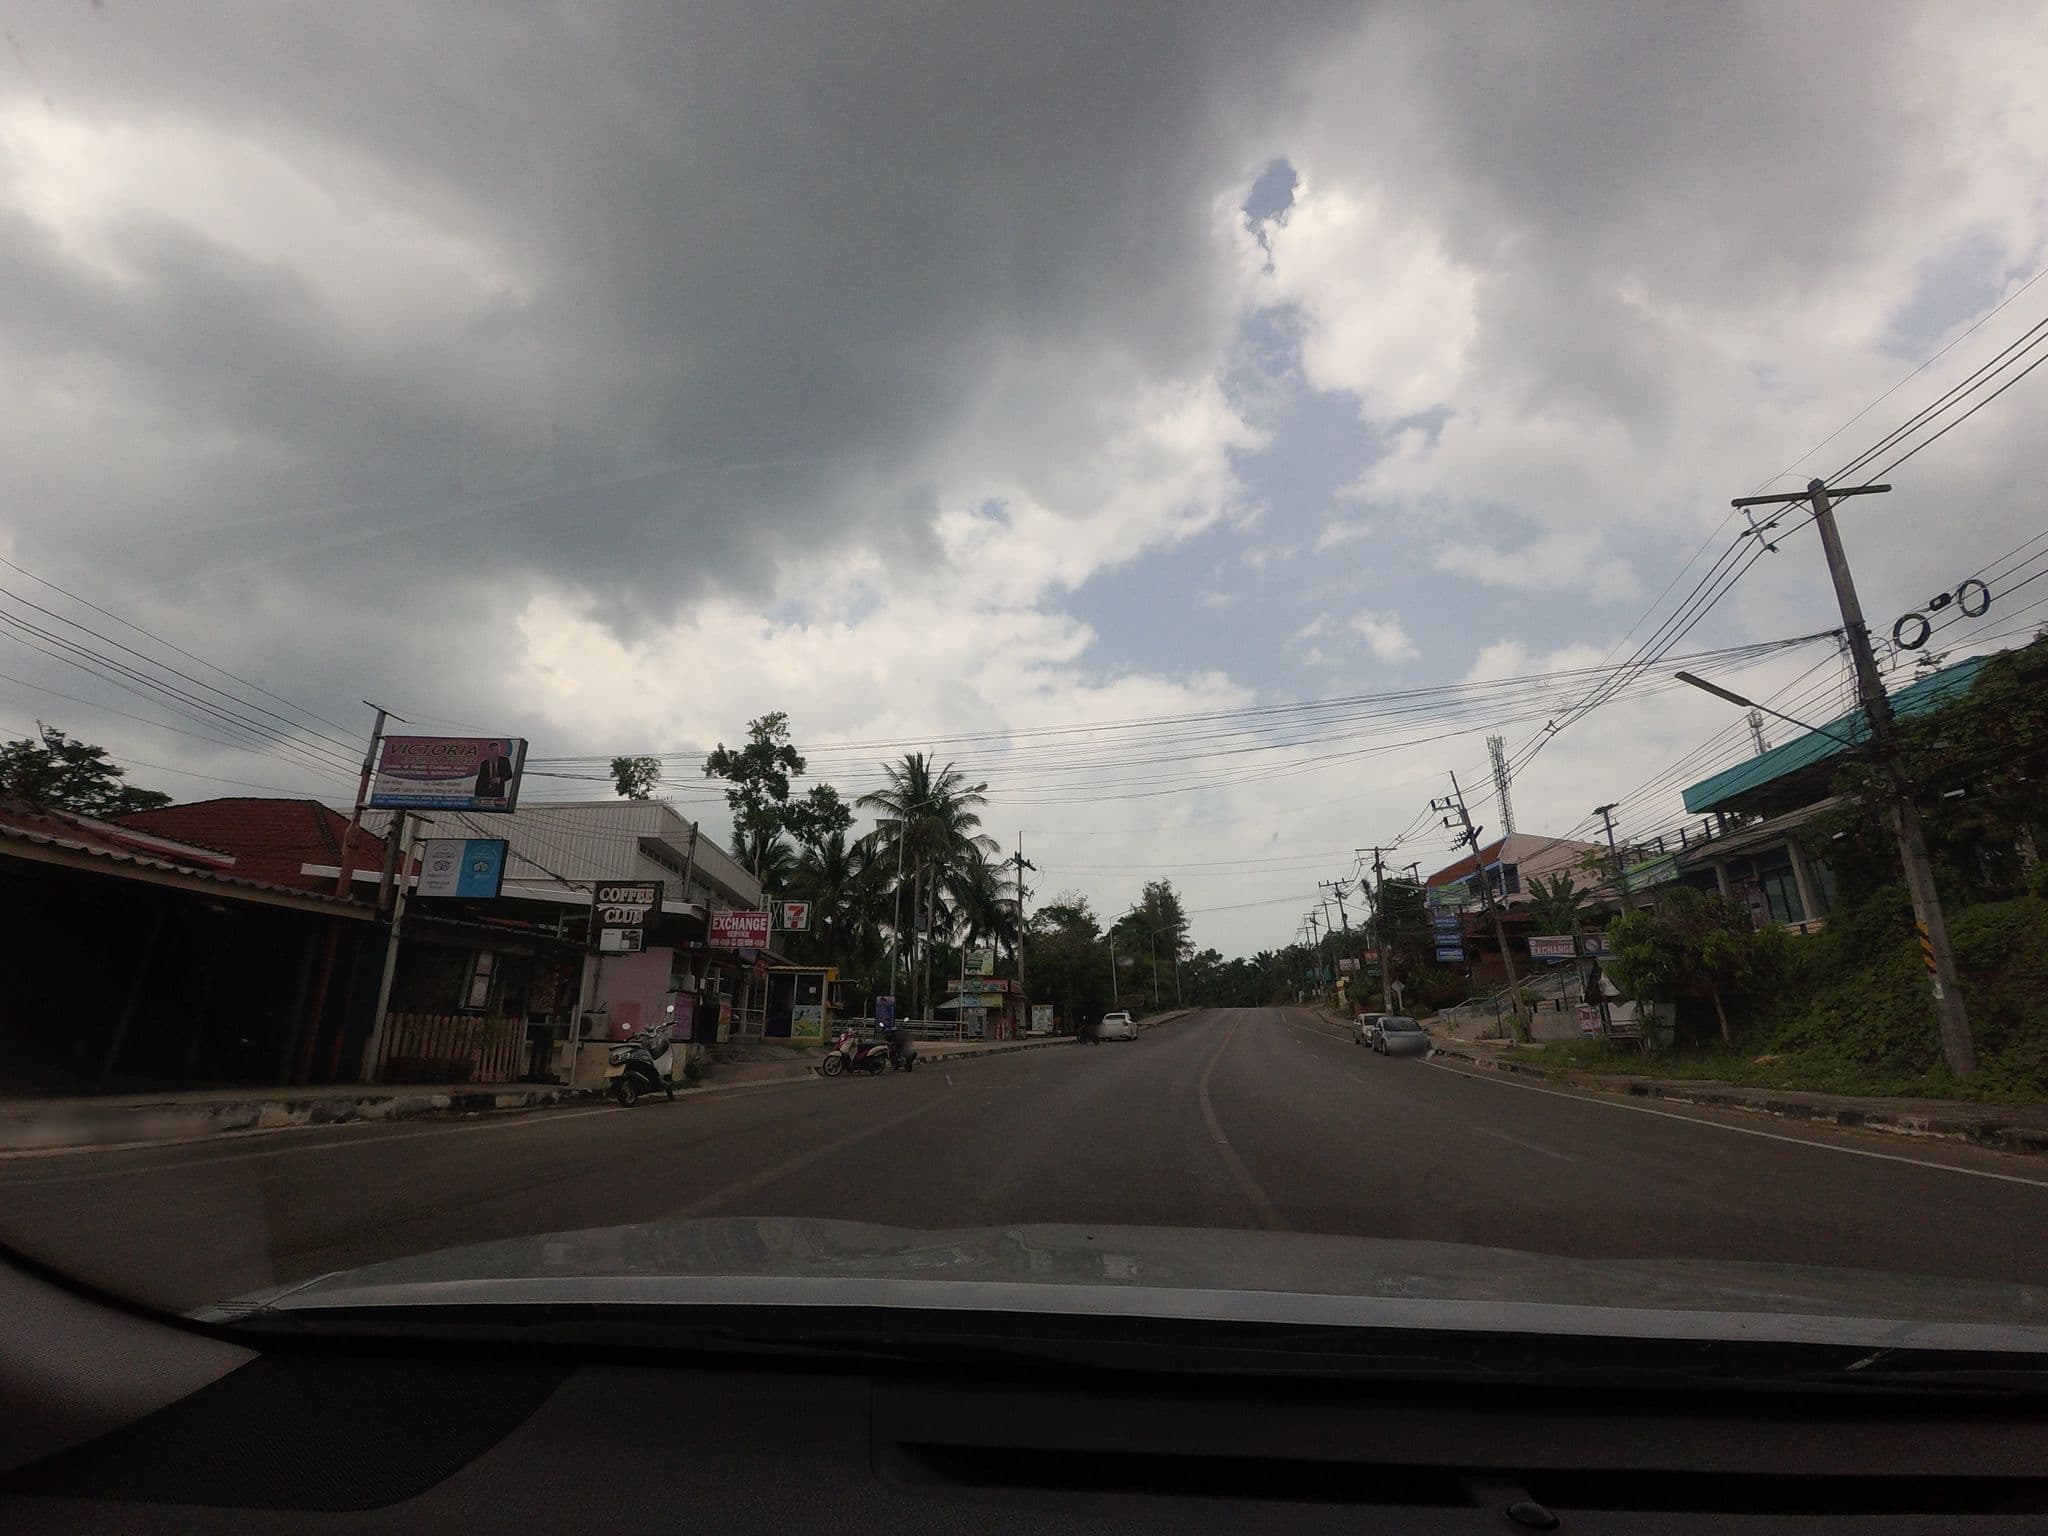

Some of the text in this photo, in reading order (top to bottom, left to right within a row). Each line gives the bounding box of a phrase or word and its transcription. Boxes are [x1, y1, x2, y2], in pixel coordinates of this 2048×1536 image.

[390, 744, 478, 757] VICTORIA
[599, 887, 655, 904] COFFEE
[604, 908, 644, 925] CLUB
[712, 917, 767, 931] EXCHANGE
[788, 905, 804, 928] 7
[1530, 944, 1575, 956] EXCHANGE
